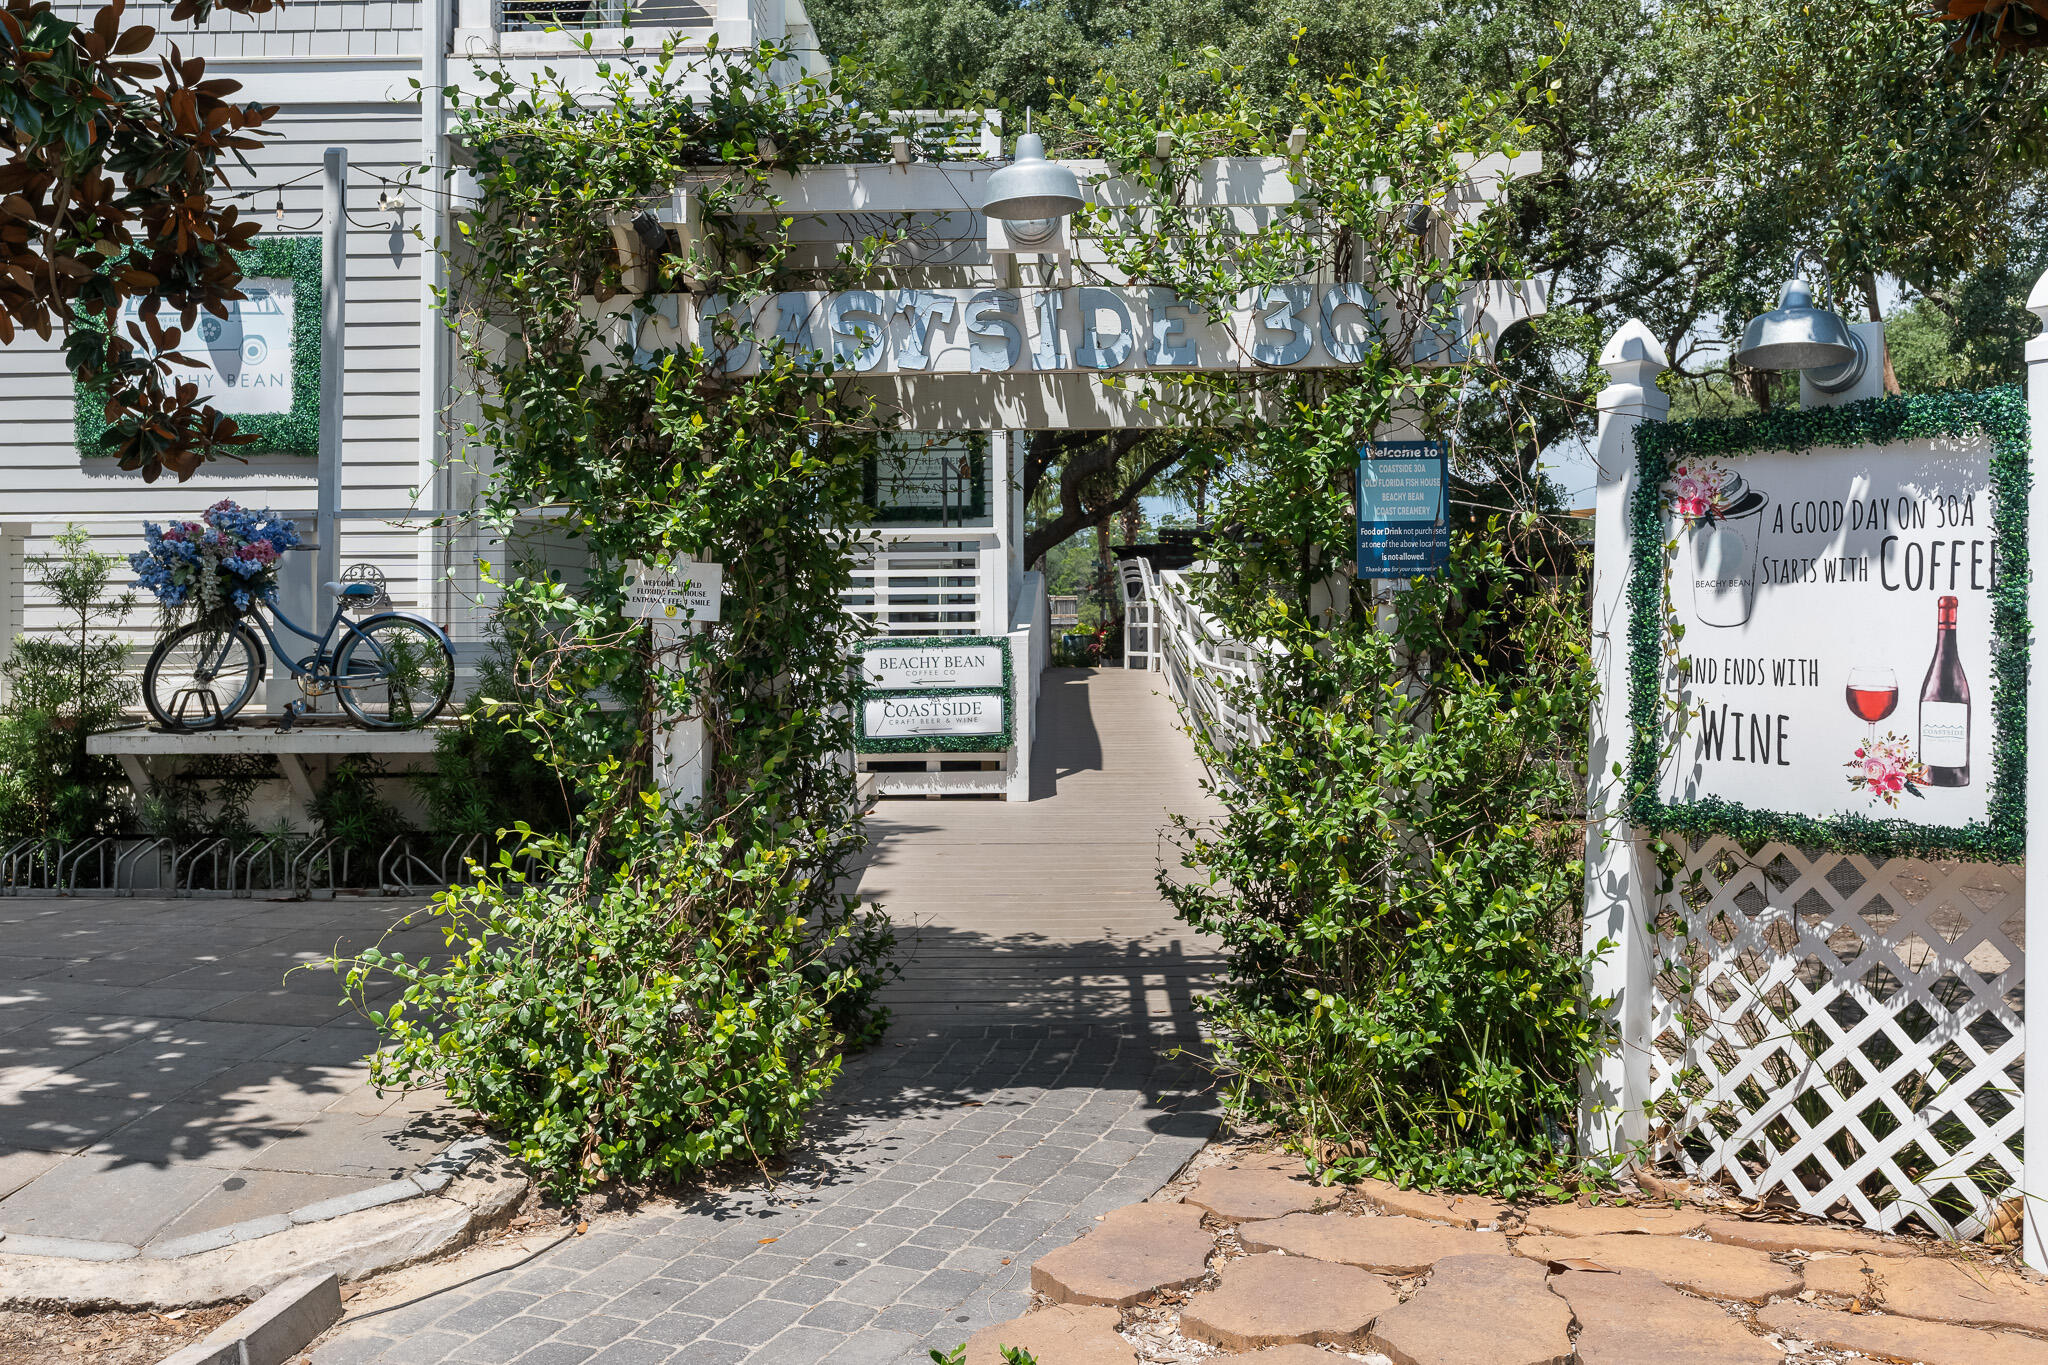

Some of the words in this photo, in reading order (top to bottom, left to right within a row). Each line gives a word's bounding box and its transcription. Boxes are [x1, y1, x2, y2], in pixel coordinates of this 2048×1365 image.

[627, 288, 1199, 373] COASTSIDE
[132, 374, 214, 388] BACHY
[227, 373, 284, 388] BEAN
[1424, 446, 1438, 457] to
[1379, 464, 1413, 473] COASTSIDE
[1414, 464, 1426, 472] 30A
[1365, 479, 1377, 487] OLD
[1378, 478, 1404, 487] FLORIDA
[1405, 478, 1420, 486] FISH
[1420, 478, 1440, 486] HOUSE
[1382, 492, 1406, 501] BEACHY
[1408, 492, 1424, 501] BEAN
[1376, 507, 1396, 516] COAST
[1397, 506, 1430, 515] CREAMERY
[1772, 503, 1784, 533] A
[1791, 500, 1844, 534] GOOD
[1852, 498, 1890, 531] DAY
[1898, 496, 1926, 530] ON
[1935, 494, 1975, 528] 30A
[1360, 527, 1376, 536] Food
[1384, 527, 1402, 535] Drink
[1414, 526, 1447, 537] purchsed
[1381, 540, 1389, 548] of
[1389, 540, 1399, 548] the
[1400, 539, 1418, 548] above
[1419, 539, 1447, 547] locatons
[1381, 552, 1387, 560] is
[1761, 556, 1817, 585] STARTS
[1824, 556, 1868, 583] WITH
[1695, 580, 1726, 588] BEACHY
[1728, 579, 1751, 588] BEAN
[880, 656, 942, 670] BEACHY
[945, 655, 985, 669] BEAN
[1683, 654, 1717, 684] AND
[1724, 658, 1765, 685] ENDS
[1773, 658, 1818, 687] WITH
[884, 702, 982, 718] COASTSIDE
[920, 717, 941, 725] BEER
[945, 717, 951, 725] &
[956, 716, 979, 724] WINE
[1700, 703, 1790, 766] WINE
